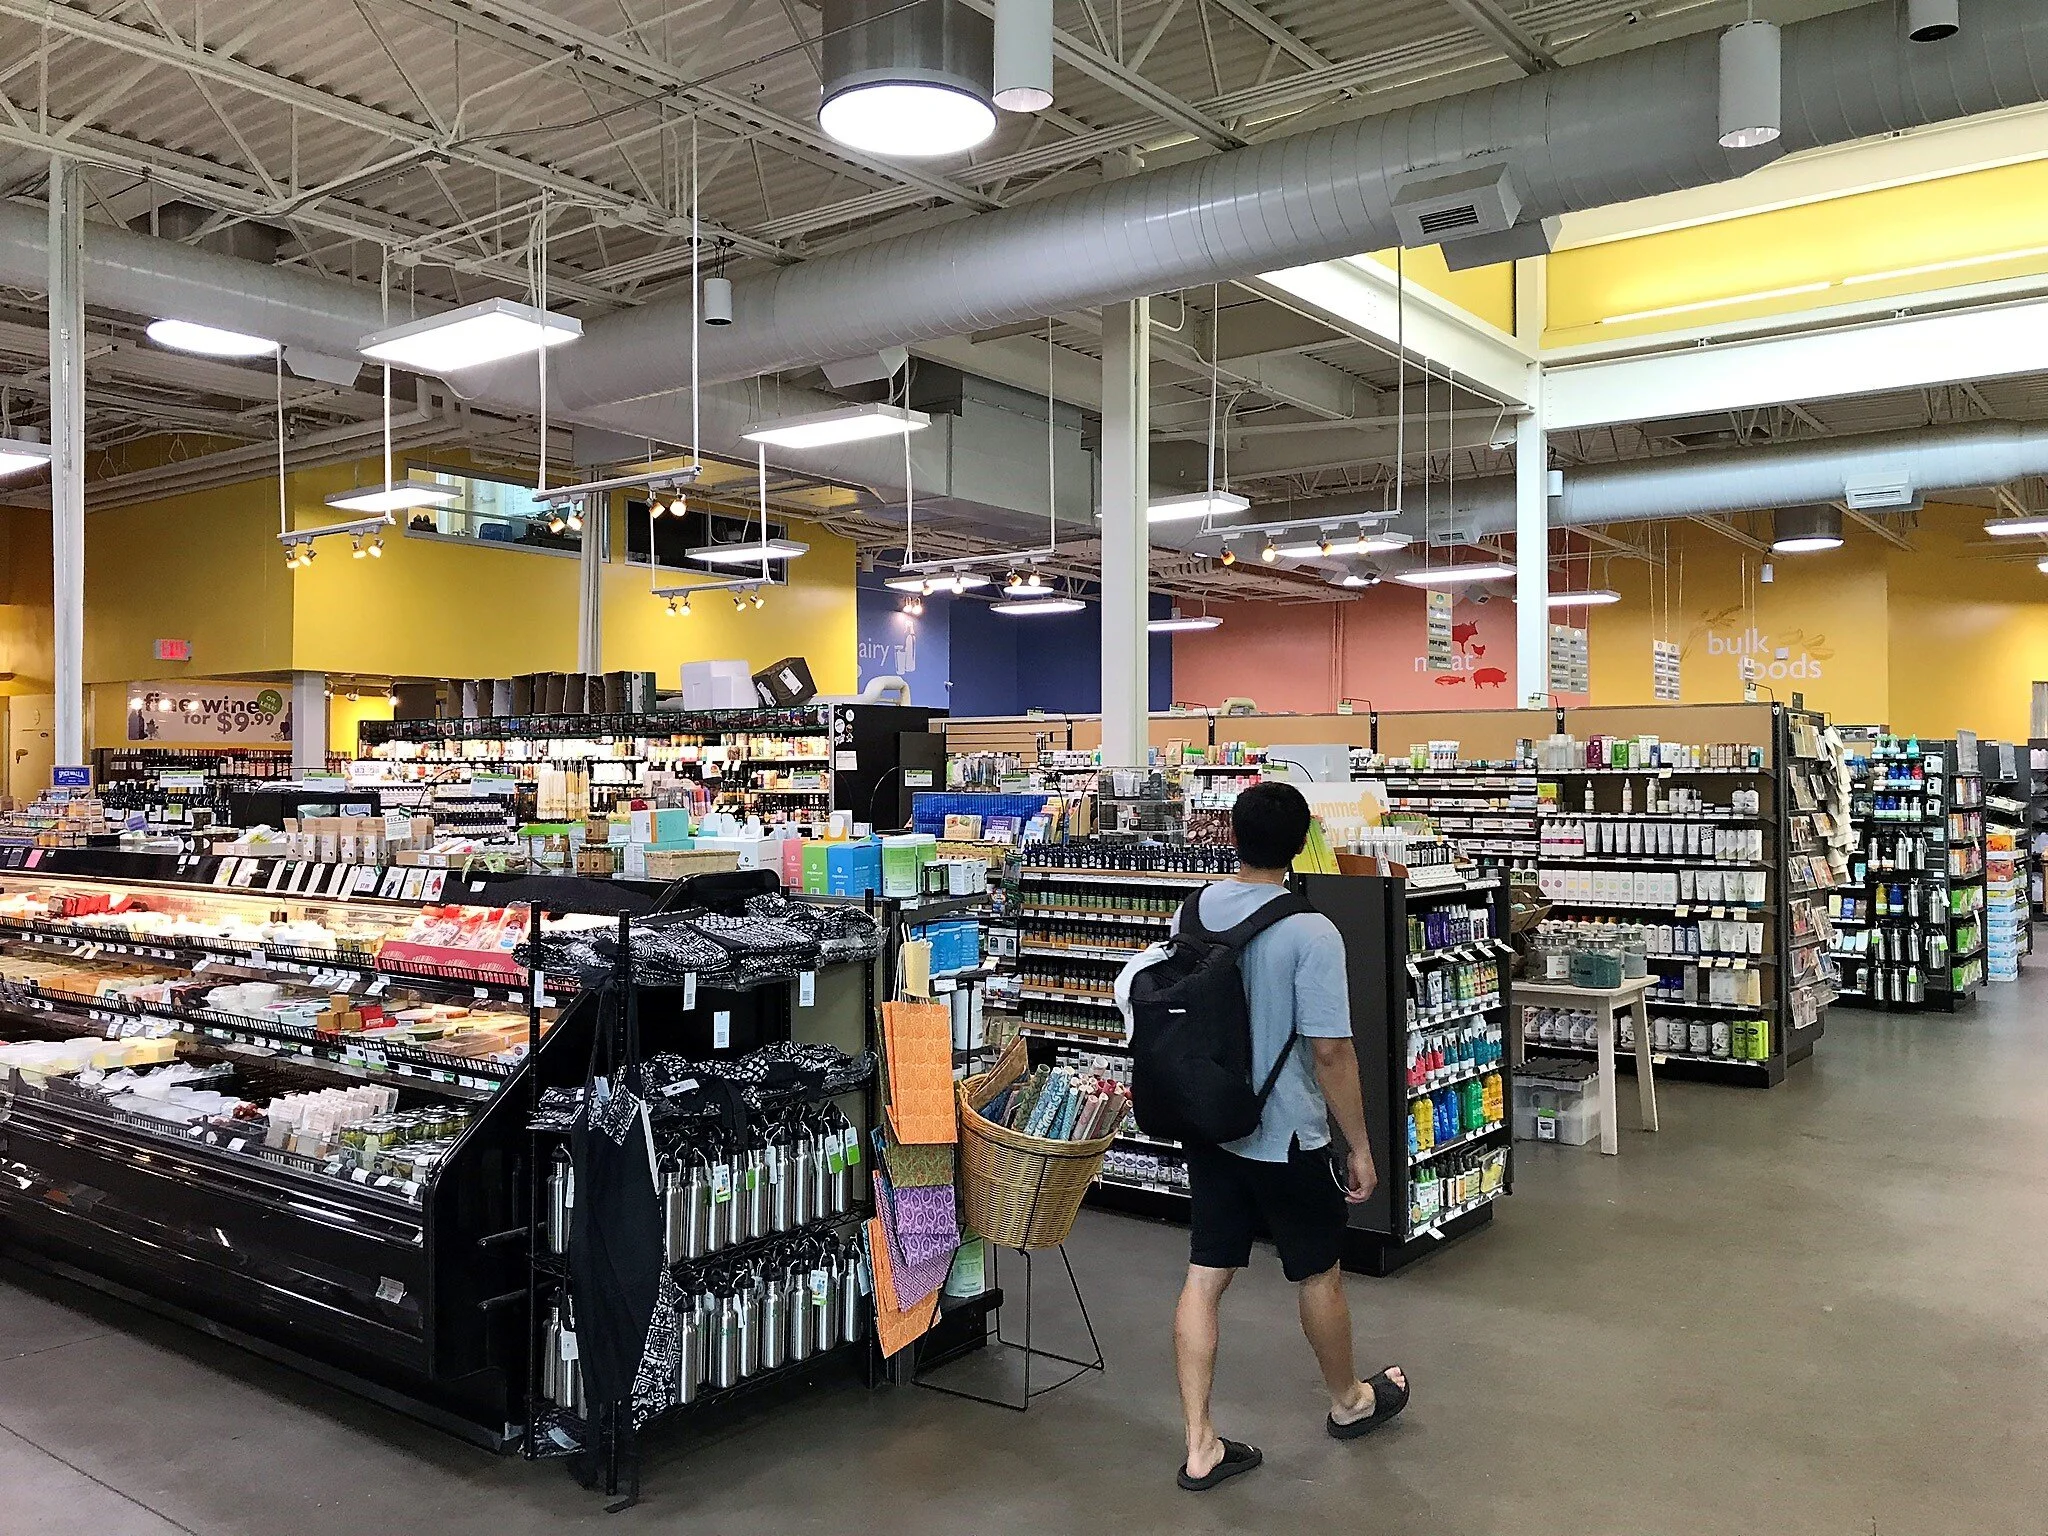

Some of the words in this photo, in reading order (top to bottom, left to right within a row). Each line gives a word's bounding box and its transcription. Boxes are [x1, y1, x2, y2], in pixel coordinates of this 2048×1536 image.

[858, 637, 890, 667] airy
[1708, 628, 1770, 655] bulk
[1414, 652, 1475, 672] mat
[202, 695, 260, 714] wine
[266, 695, 276, 704] OR
[183, 712, 211, 725] for
[217, 711, 274, 734] $9.99
